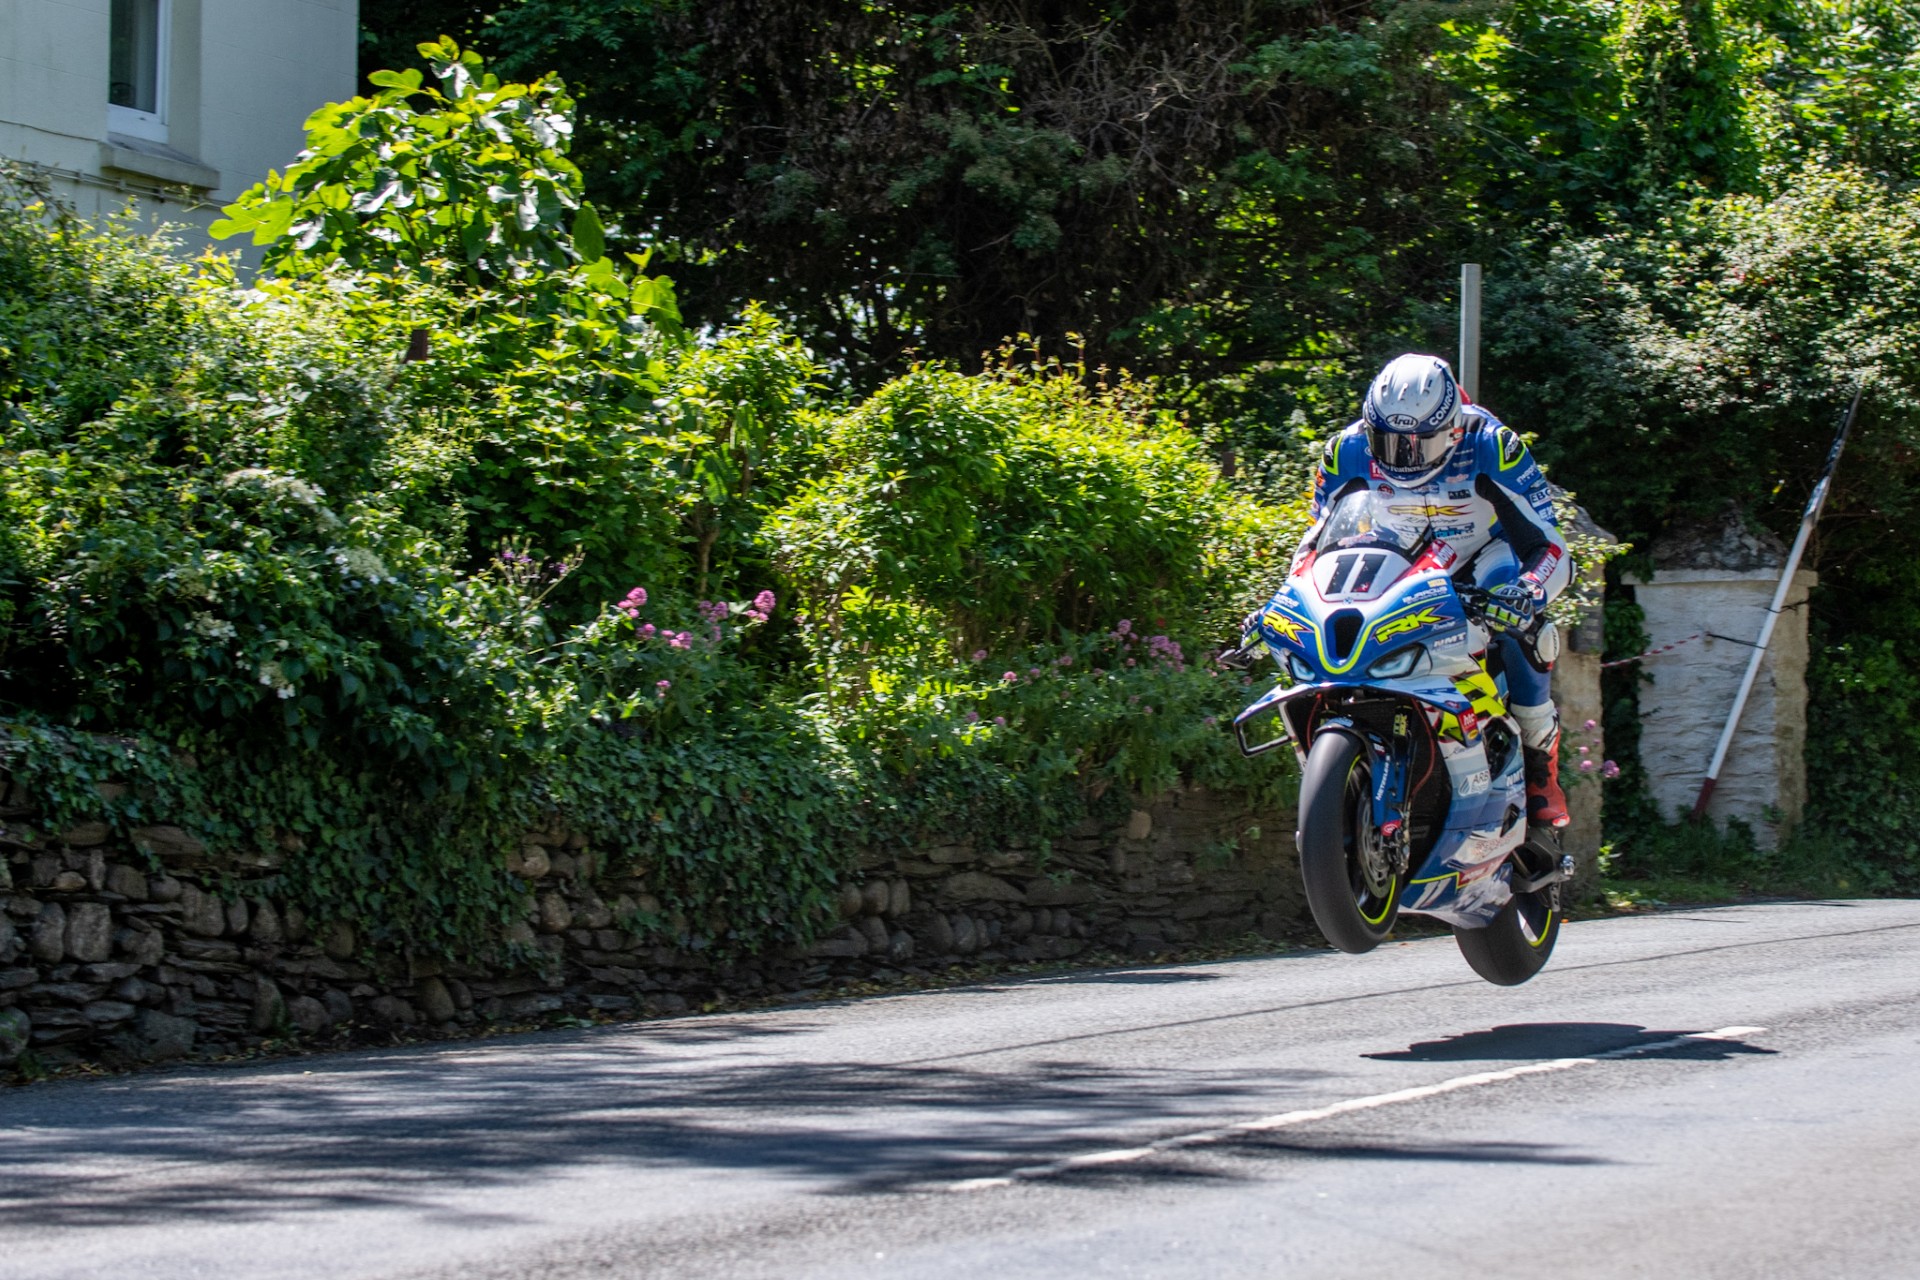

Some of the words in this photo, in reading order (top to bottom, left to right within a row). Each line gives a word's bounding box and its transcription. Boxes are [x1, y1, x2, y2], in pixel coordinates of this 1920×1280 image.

[1388, 415, 1416, 427] Arai
[1429, 381, 1455, 426] CONROD
[1325, 553, 1387, 595] 11
[1262, 610, 1309, 643] RK
[1373, 604, 1446, 645] RK
